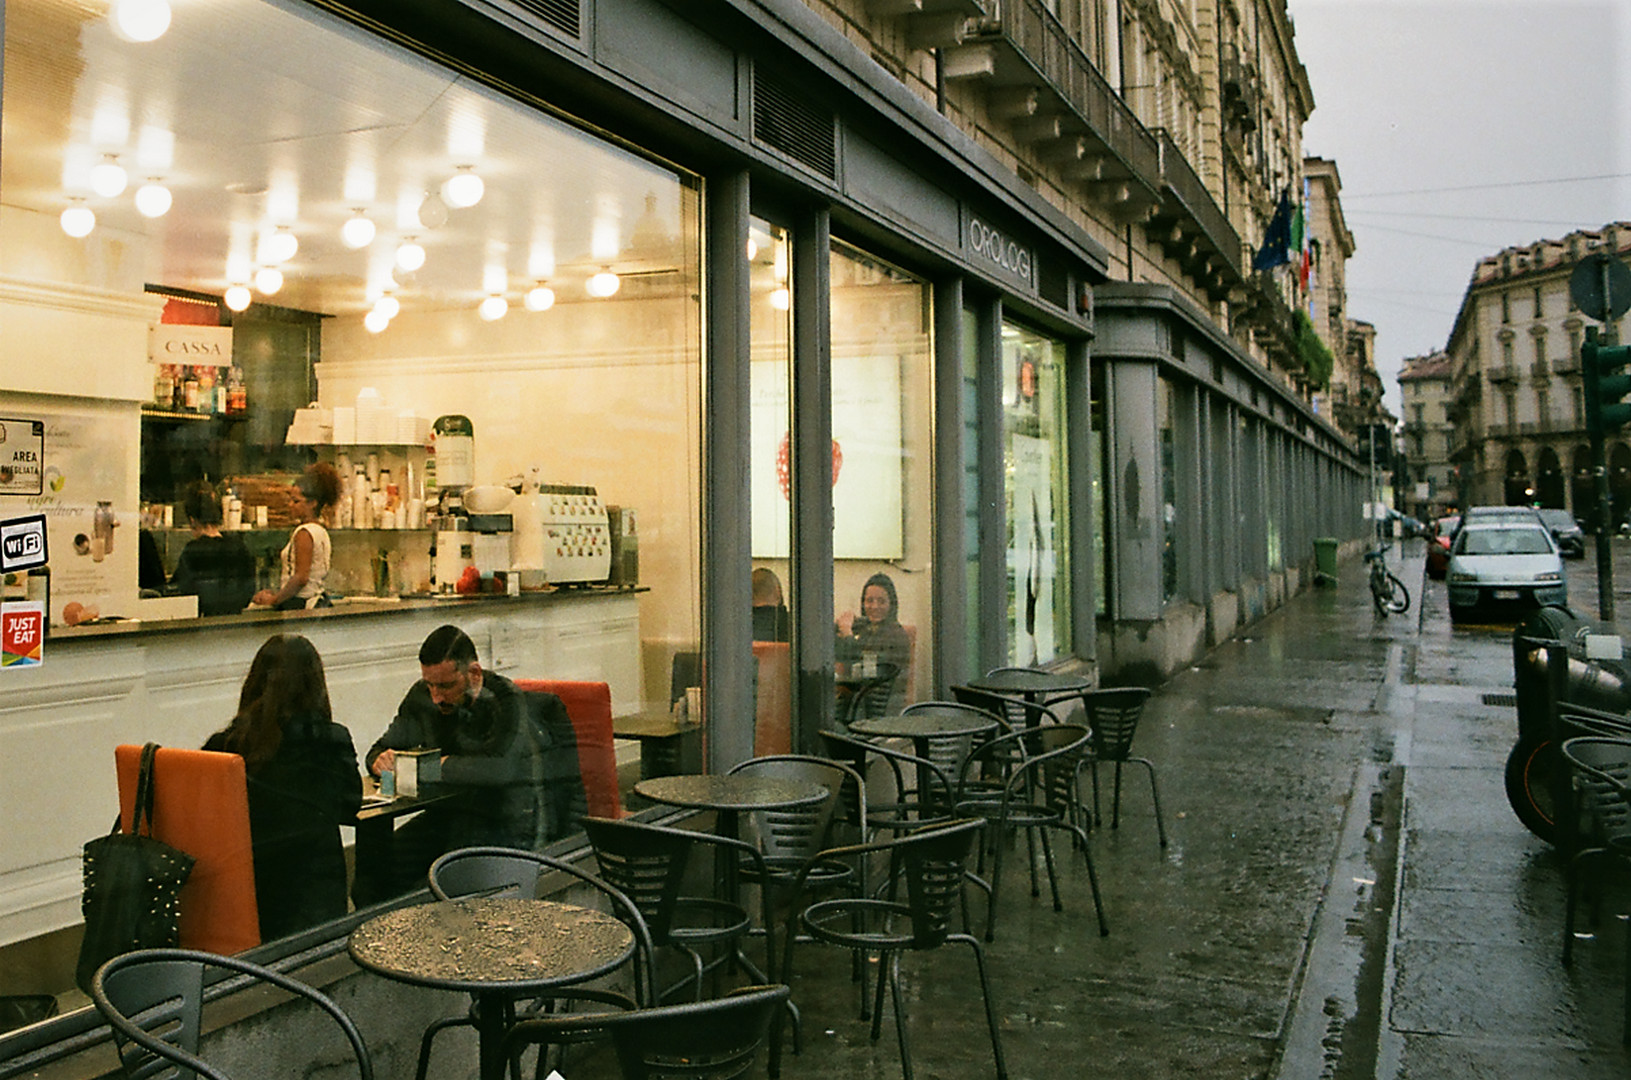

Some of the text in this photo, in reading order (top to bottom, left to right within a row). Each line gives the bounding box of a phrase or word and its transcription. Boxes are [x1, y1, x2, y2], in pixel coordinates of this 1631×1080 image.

[970, 218, 1031, 281] OROLOGI
[165, 340, 221, 355] CASSA
[13, 451, 37, 462] AREA
[6, 535, 39, 554] WiFi
[8, 616, 36, 633] JUST
[13, 630, 36, 644] EAT
